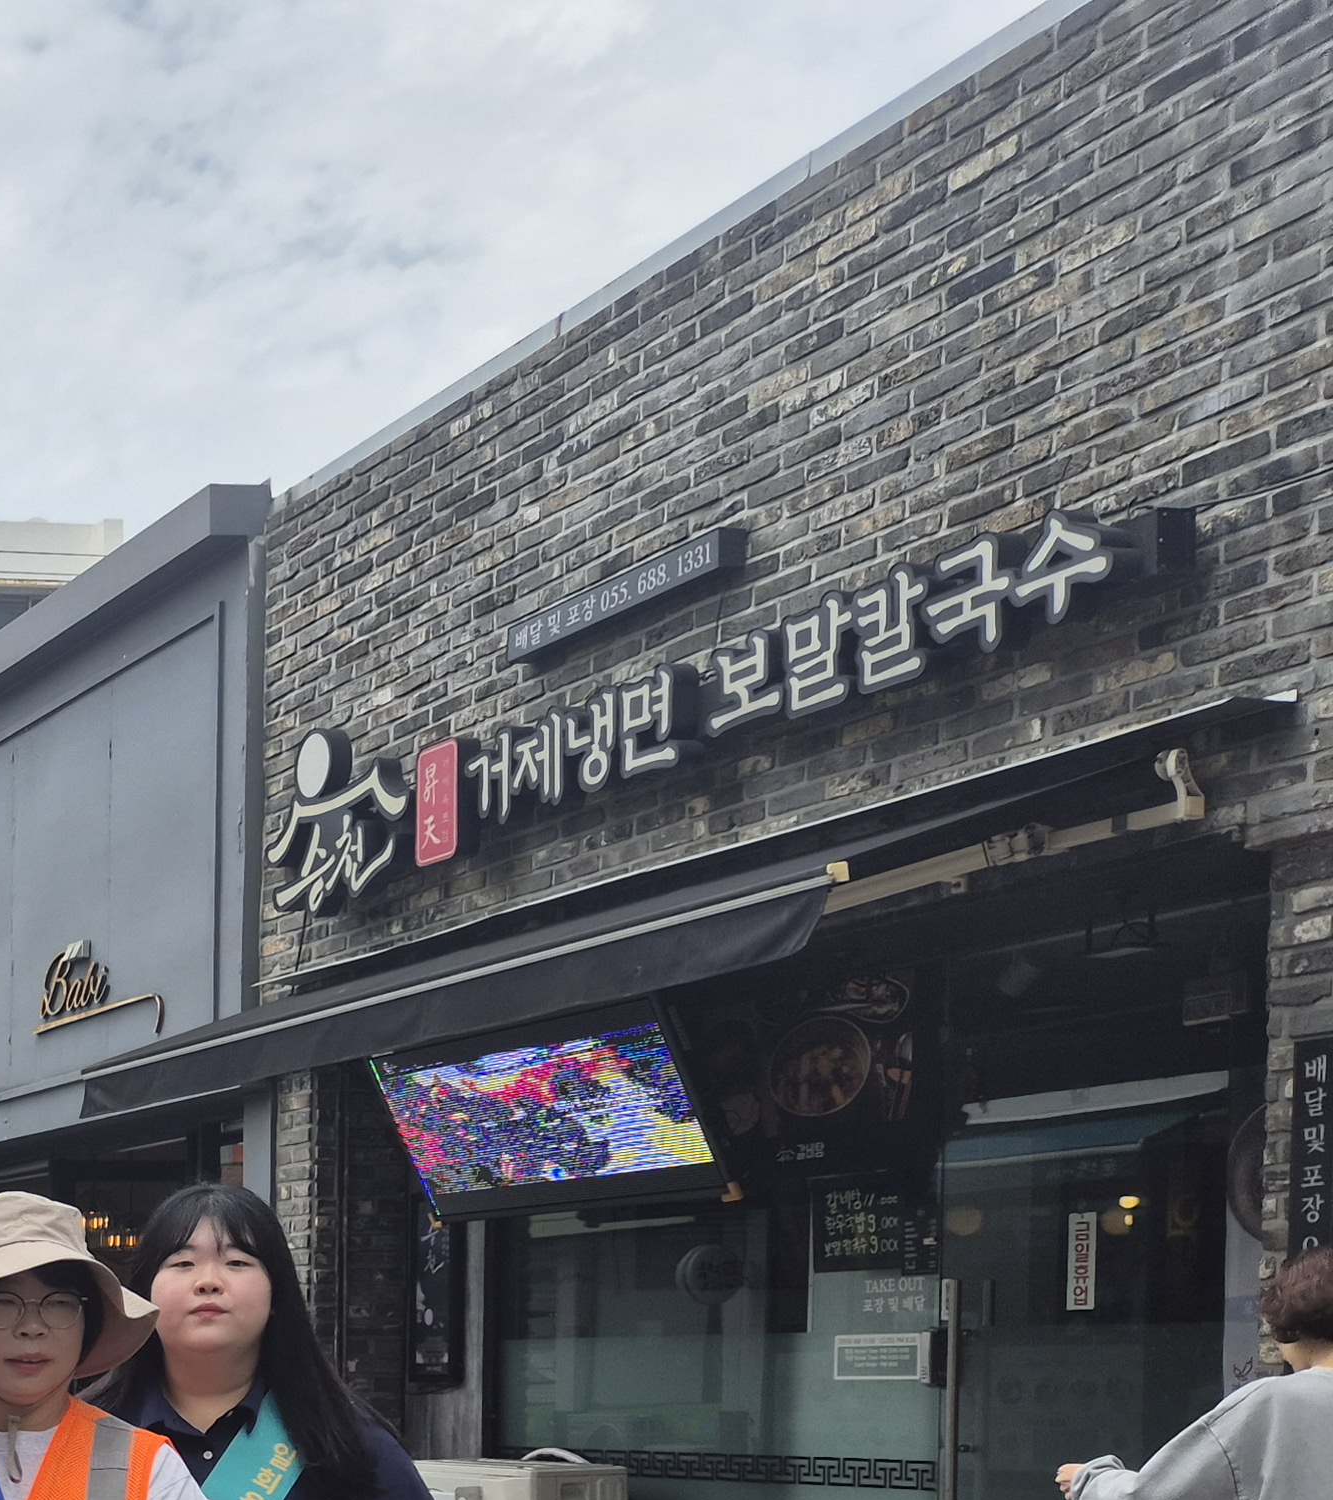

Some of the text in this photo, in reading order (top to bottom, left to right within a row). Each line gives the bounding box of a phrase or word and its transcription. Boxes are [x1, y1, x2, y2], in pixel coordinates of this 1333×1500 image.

[515, 542, 712, 650] 배달 및 포장 055. 688. 1331
[466, 670, 676, 818] 거제냉면
[711, 519, 1109, 731] 보말칼국수
[276, 813, 395, 912] 승천
[1303, 1054, 1328, 1117] 배달
[1303, 1125, 1326, 1154] 및
[1300, 1165, 1325, 1223] 포장
[864, 1276, 926, 1294] TAKE OUT
[1073, 1221, 1091, 1307] 금일휴업
[862, 1298, 884, 1313] 포장
